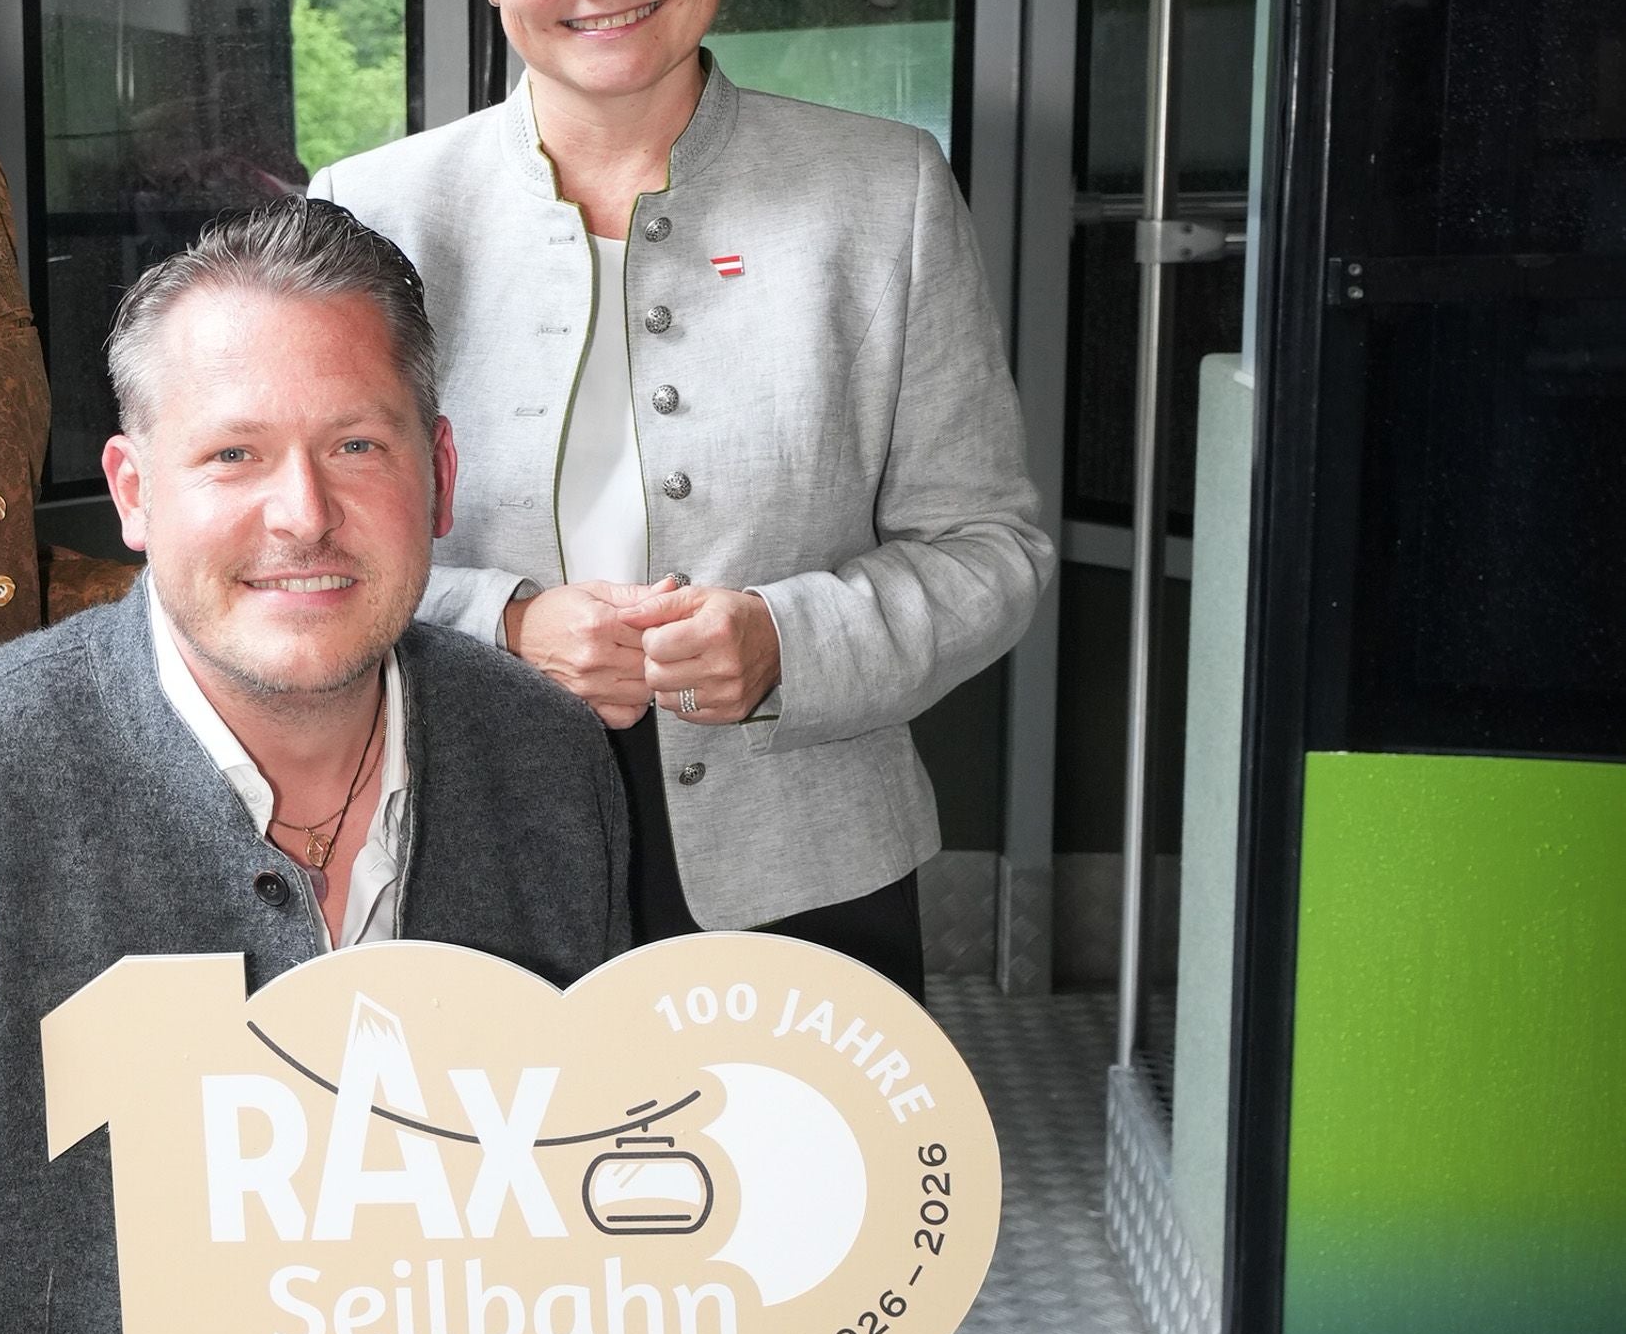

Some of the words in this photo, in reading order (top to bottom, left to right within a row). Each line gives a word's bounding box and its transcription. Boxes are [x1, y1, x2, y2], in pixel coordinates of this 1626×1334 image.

[201, 991, 569, 1243] RAX
[654, 983, 758, 1032] 100
[773, 988, 937, 1125] JAHRE
[913, 1143, 951, 1256] 2026
